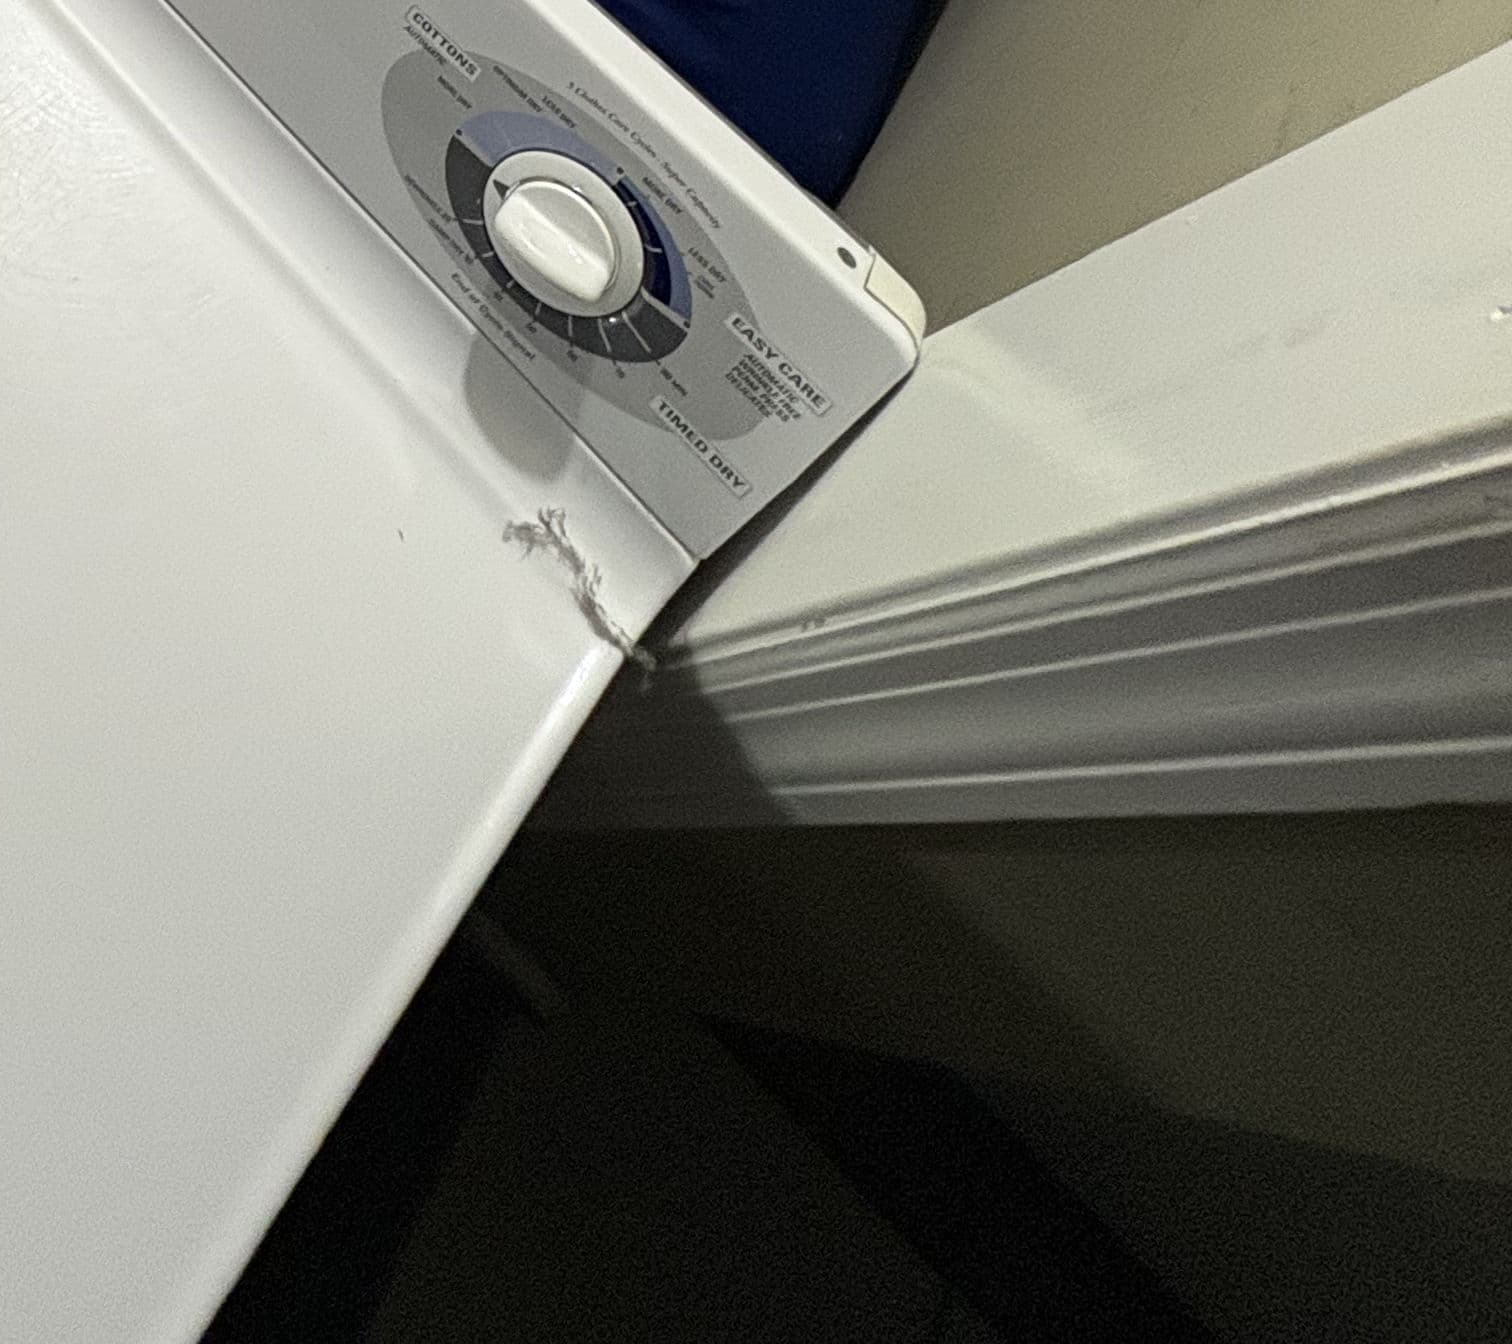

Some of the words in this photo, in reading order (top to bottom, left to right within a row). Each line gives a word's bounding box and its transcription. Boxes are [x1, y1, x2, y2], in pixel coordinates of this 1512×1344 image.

[403, 24, 447, 66] AUTOMATIC
[412, 12, 478, 77] COTTONS
[437, 75, 458, 98] MORE
[456, 94, 473, 110] DRY
[526, 97, 544, 113] DRY
[559, 112, 577, 129] DRY
[451, 272, 471, 293] End
[688, 246, 710, 269] LESS
[707, 265, 728, 284] DRY
[731, 316, 780, 361] EASY
[778, 362, 827, 410] CARE
[744, 353, 801, 405] AUTOMATIC
[725, 372, 772, 418] DELICATES
[709, 453, 746, 489] DRY
